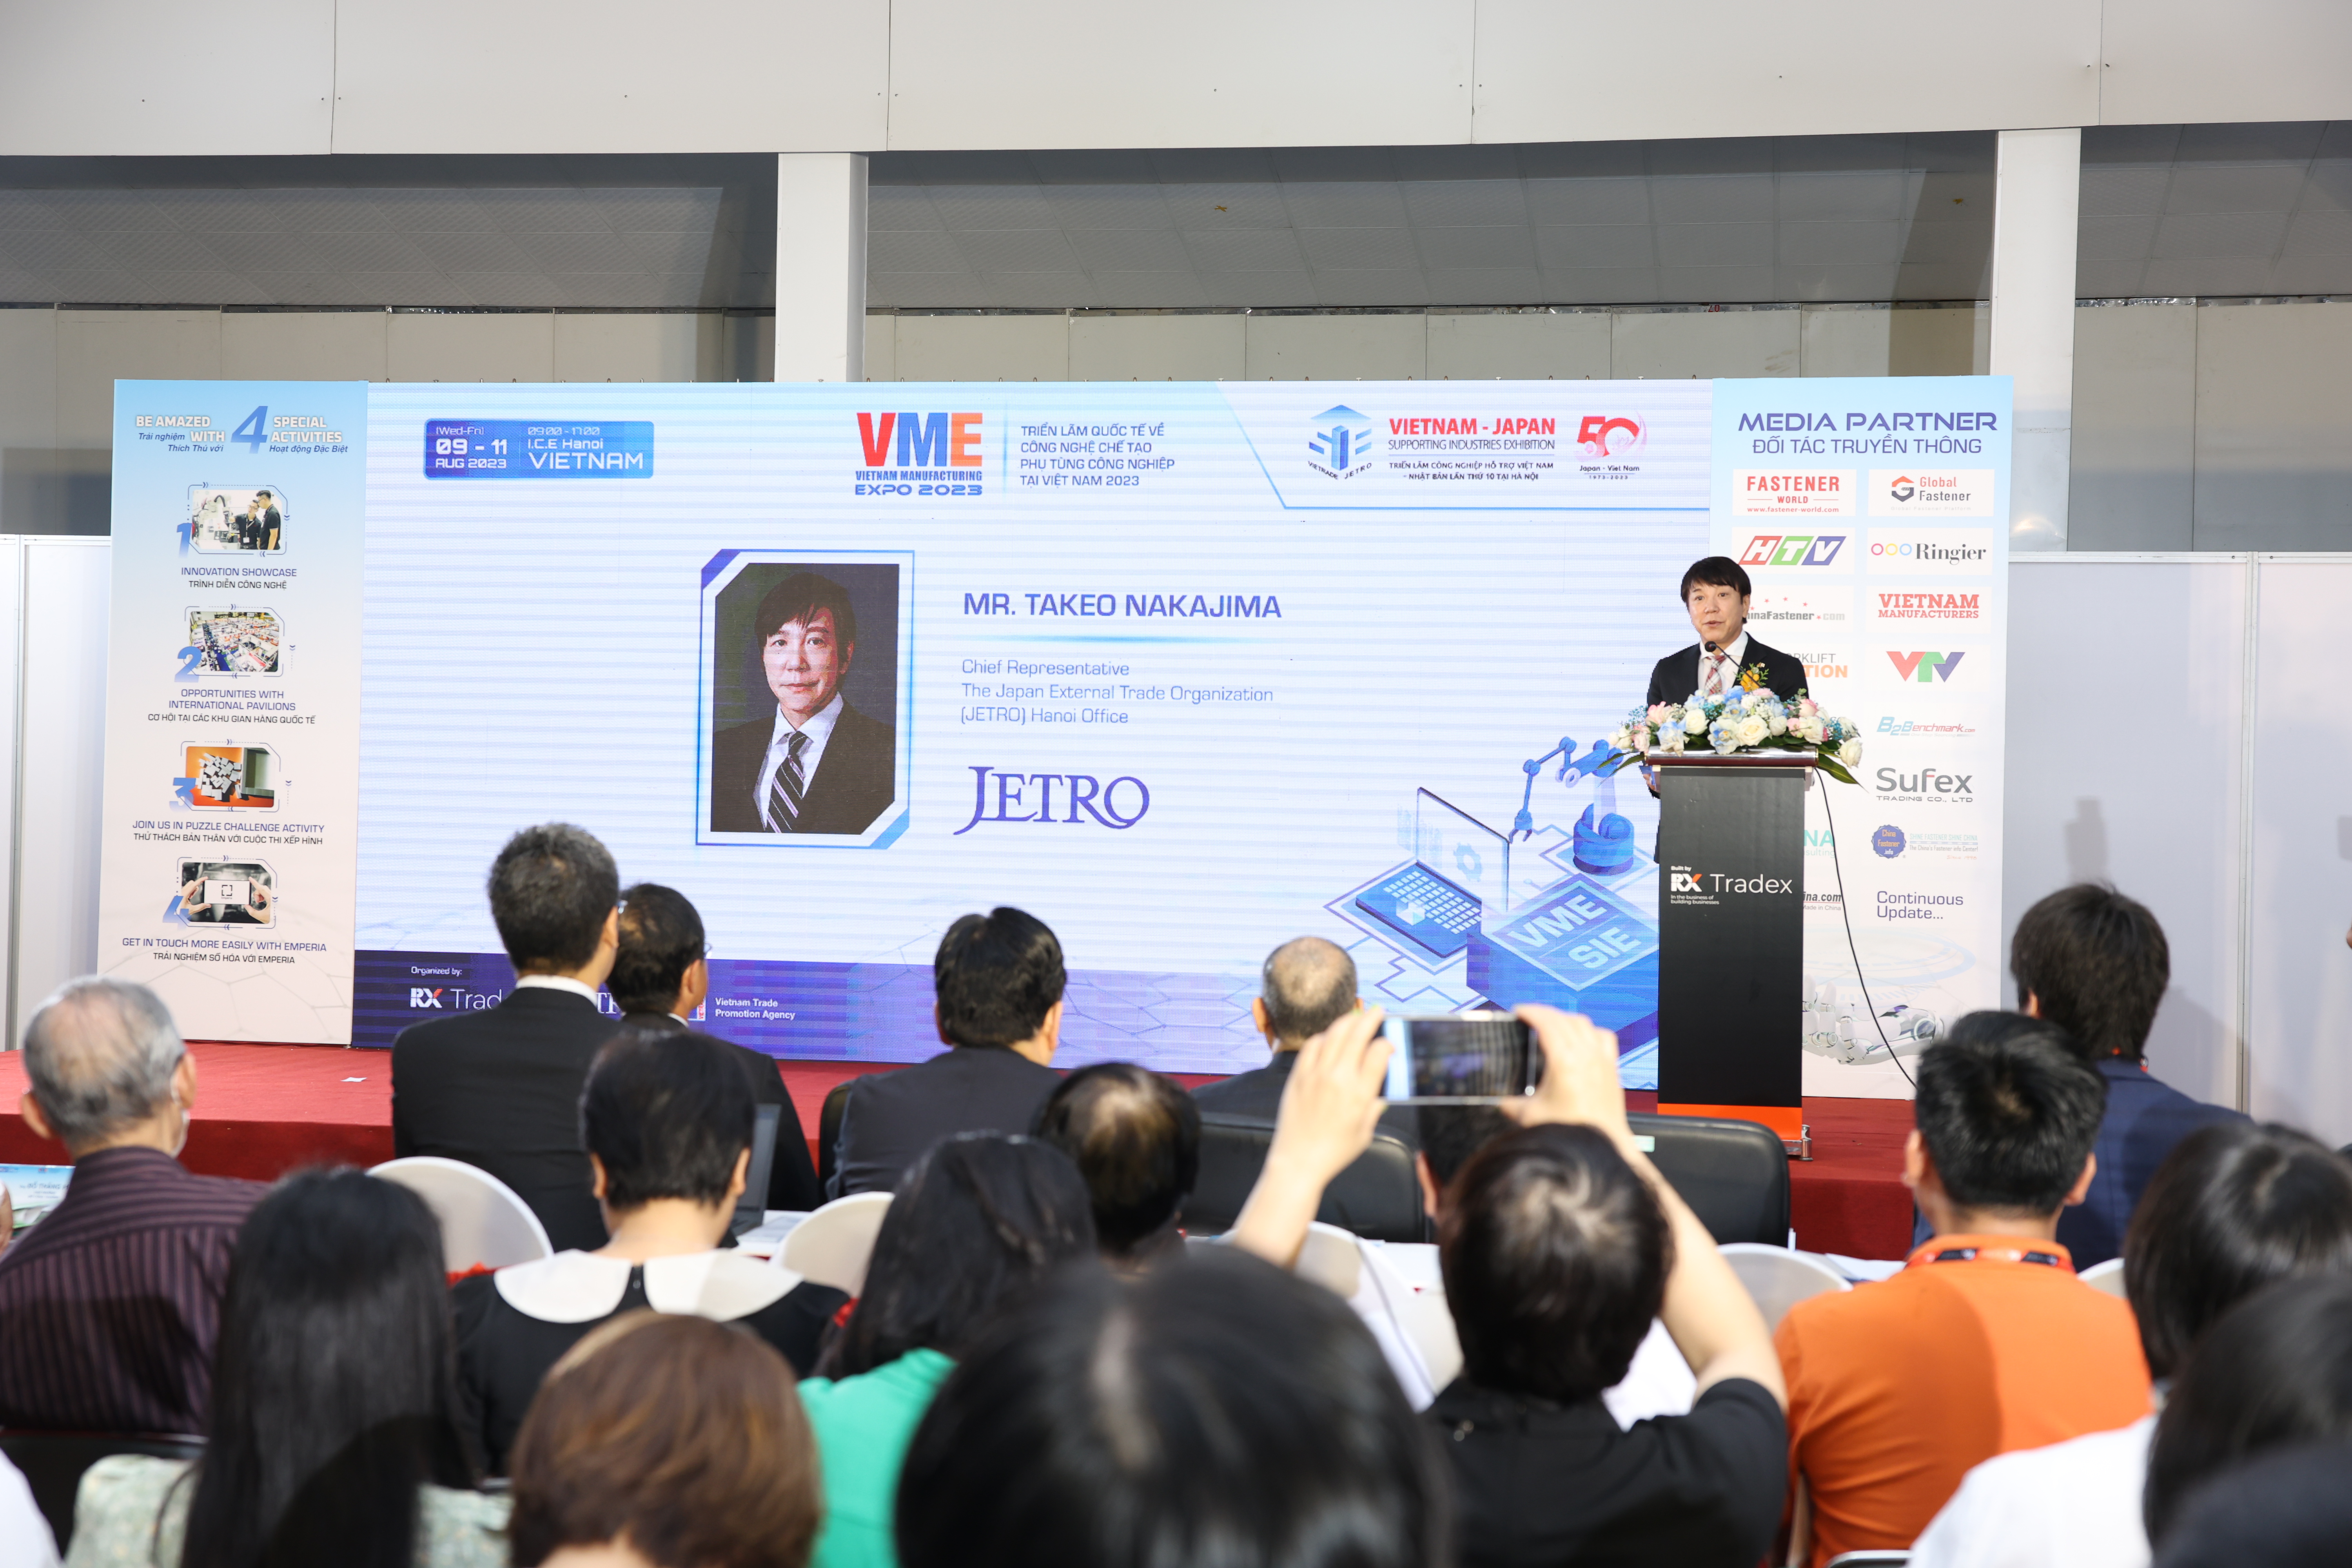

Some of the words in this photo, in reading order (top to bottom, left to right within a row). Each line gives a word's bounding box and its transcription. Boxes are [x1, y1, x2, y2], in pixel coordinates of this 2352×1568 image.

[136, 416, 152, 427] BE
[155, 416, 210, 427] AMAZED
[273, 416, 327, 428] SPECIAL
[1389, 418, 1477, 435] VIETNAM
[1493, 418, 1555, 435] JAPAN
[1738, 412, 1837, 431] MEDIA
[1847, 412, 1998, 430] PARTNER
[190, 431, 225, 442] WITH
[230, 405, 268, 454] 4
[1093, 423, 1126, 437] QUỐC
[1129, 423, 1145, 436] TẾ
[139, 433, 153, 441] Trải
[155, 433, 185, 441] nghiệm
[270, 431, 342, 443] ACTIVITIES
[562, 438, 603, 449] Hanoi
[857, 412, 983, 467] VME
[1753, 436, 1784, 454] ĐỐI
[1790, 436, 1825, 454] TÁC
[1831, 434, 1907, 454] TRUYỀN
[1913, 436, 1982, 454] THÔNG
[269, 445, 288, 454] Hoạt
[290, 445, 311, 454] động
[314, 445, 329, 454] Đặc
[332, 445, 348, 454] Biệt
[436, 439, 467, 455] 09
[491, 439, 507, 454] 11
[1021, 441, 1056, 453] CÔNG
[1060, 441, 1095, 456] NGHỆ
[1099, 440, 1125, 453] CHẾ
[1127, 442, 1152, 456] TẠO
[1388, 440, 1446, 450] SUPPORTING
[1450, 440, 1501, 450] INDUSTRIES
[1504, 440, 1555, 450] EXHIBITION
[436, 458, 464, 468] AUG
[467, 459, 506, 468] 2023
[528, 452, 643, 469] VIETNAM
[1020, 459, 1047, 472] PHỤ
[1050, 456, 1085, 470] TÙNG
[1088, 457, 1124, 470] CÔNG
[1128, 458, 1175, 472] NGHIỆP
[856, 471, 897, 481] VIETNAM
[900, 470, 982, 481] MANUFACTURING
[1020, 475, 1040, 488] TẠI
[1042, 474, 1069, 488] VIỆT
[1072, 475, 1103, 486] NAM
[1106, 475, 1139, 486] 2023
[1920, 477, 1956, 488] Global
[855, 485, 911, 495] EXPO
[919, 485, 982, 495] 2023
[1748, 476, 1839, 492] FASTENER
[1920, 490, 1971, 502] Fastener
[1915, 543, 1986, 565] Ringier
[181, 567, 239, 576] INNOVATION
[242, 568, 297, 577] SHOWCASE
[189, 579, 214, 588] TRÌNH
[216, 578, 236, 588] DIỄN
[238, 579, 261, 588] CÔNG
[263, 579, 287, 590] NGHỆ
[964, 593, 1016, 615] MR.
[1025, 594, 1116, 616] TAKEO
[1126, 595, 1282, 618] NAKAJIMA
[1879, 594, 1979, 608] VIETNAM
[1878, 610, 1979, 618] MANUFACTURERS
[962, 660, 1001, 674] Chief
[1007, 660, 1129, 677] Representative
[1886, 651, 1965, 682] VTV
[181, 689, 256, 698] OPPORTUNITIES
[259, 690, 284, 699] WITH
[962, 684, 991, 698] The
[996, 684, 1044, 701] Japan
[1050, 685, 1114, 699] External
[1120, 685, 1165, 700] Trade
[1171, 686, 1273, 704] Organization
[169, 701, 244, 710] INTERNATIONAL
[247, 702, 296, 711] PAVILIONS
[148, 713, 160, 721] CƠ
[162, 713, 176, 723] HỘI
[178, 713, 191, 724] TẠI
[193, 712, 209, 722] CÁC
[254, 712, 278, 724] HÀNG
[280, 713, 303, 724] QUỐC
[305, 713, 315, 724] TẾ
[961, 708, 1025, 724] (JETRO)
[1032, 708, 1076, 723] Hanoi
[1082, 708, 1128, 723] Office
[1877, 768, 1973, 794] Sufex
[953, 766, 1150, 835] JETRO
[132, 820, 155, 829] JOIN
[158, 821, 171, 829] US
[173, 821, 183, 829] IN
[186, 822, 221, 830] PUZZLE
[224, 822, 280, 832] CHALLENGE
[282, 824, 325, 833] ACTIVITY
[134, 831, 151, 841] THỬ
[153, 831, 181, 841] THÁCH
[183, 831, 200, 842] BẢN
[203, 833, 226, 842] THÂN
[228, 834, 241, 843] VỚI
[243, 834, 267, 845] CUỘC
[283, 834, 300, 844] XẾP
[302, 835, 323, 844] HÌNH
[1671, 873, 1703, 892] RX
[1710, 873, 1792, 893] Tradex
[1877, 891, 1963, 906] Continuous
[1877, 906, 1943, 921] Update...
[1506, 894, 1608, 948] VME
[122, 938, 140, 946] GET
[143, 938, 153, 947] IN
[155, 939, 188, 947] TOUCH
[191, 940, 219, 948] MORE
[222, 940, 254, 950] EASILY
[256, 942, 281, 951] WITH
[284, 942, 327, 951] EMPERIA
[1568, 927, 1642, 968] SIE
[153, 951, 171, 960] TRẢI
[173, 953, 207, 963] NGHIỆM
[209, 952, 221, 961] SỐ
[223, 953, 241, 962] HÓA
[242, 954, 256, 962] VỚI
[258, 955, 295, 963] EMPERIA
[411, 966, 450, 976] Organized
[410, 987, 443, 1008] RX
[715, 998, 750, 1007] Vietnam
[753, 998, 778, 1007] Trade
[715, 1009, 760, 1018] Promotion
[762, 1010, 795, 1020] Agency
